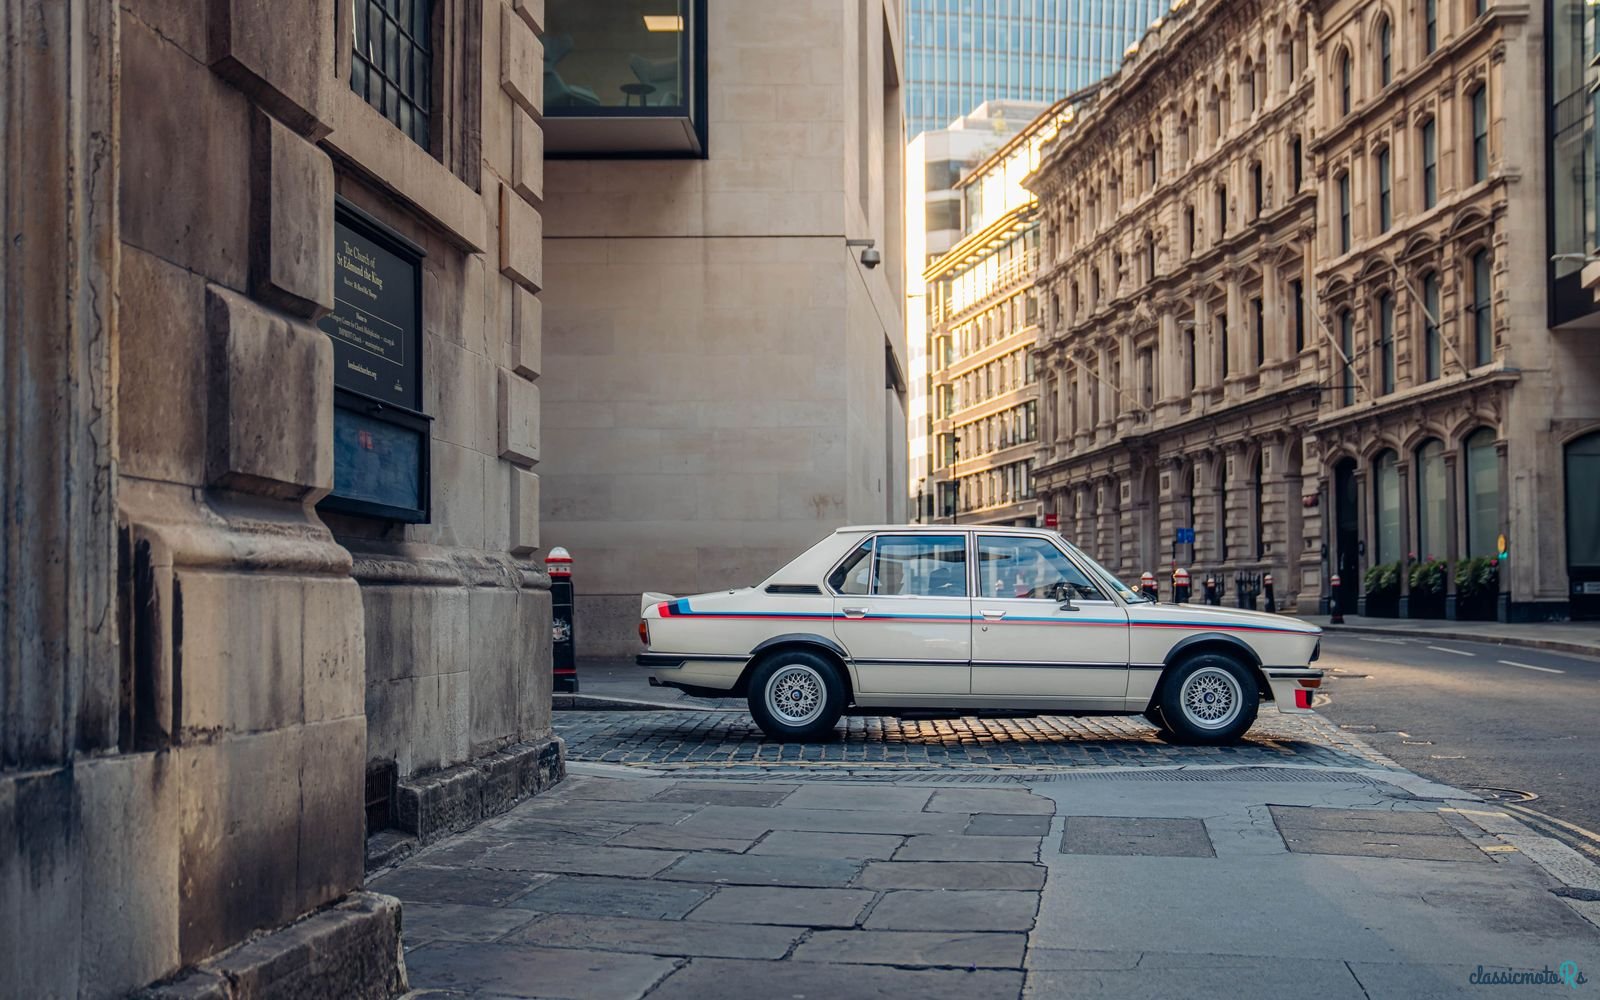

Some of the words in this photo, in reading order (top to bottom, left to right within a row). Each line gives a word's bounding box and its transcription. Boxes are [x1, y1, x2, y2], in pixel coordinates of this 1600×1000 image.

[344, 241, 353, 256] The
[353, 246, 370, 265] Church
[370, 257, 376, 268] of
[336, 252, 343, 267] St
[343, 256, 364, 277] Edmund
[371, 270, 383, 290] King
